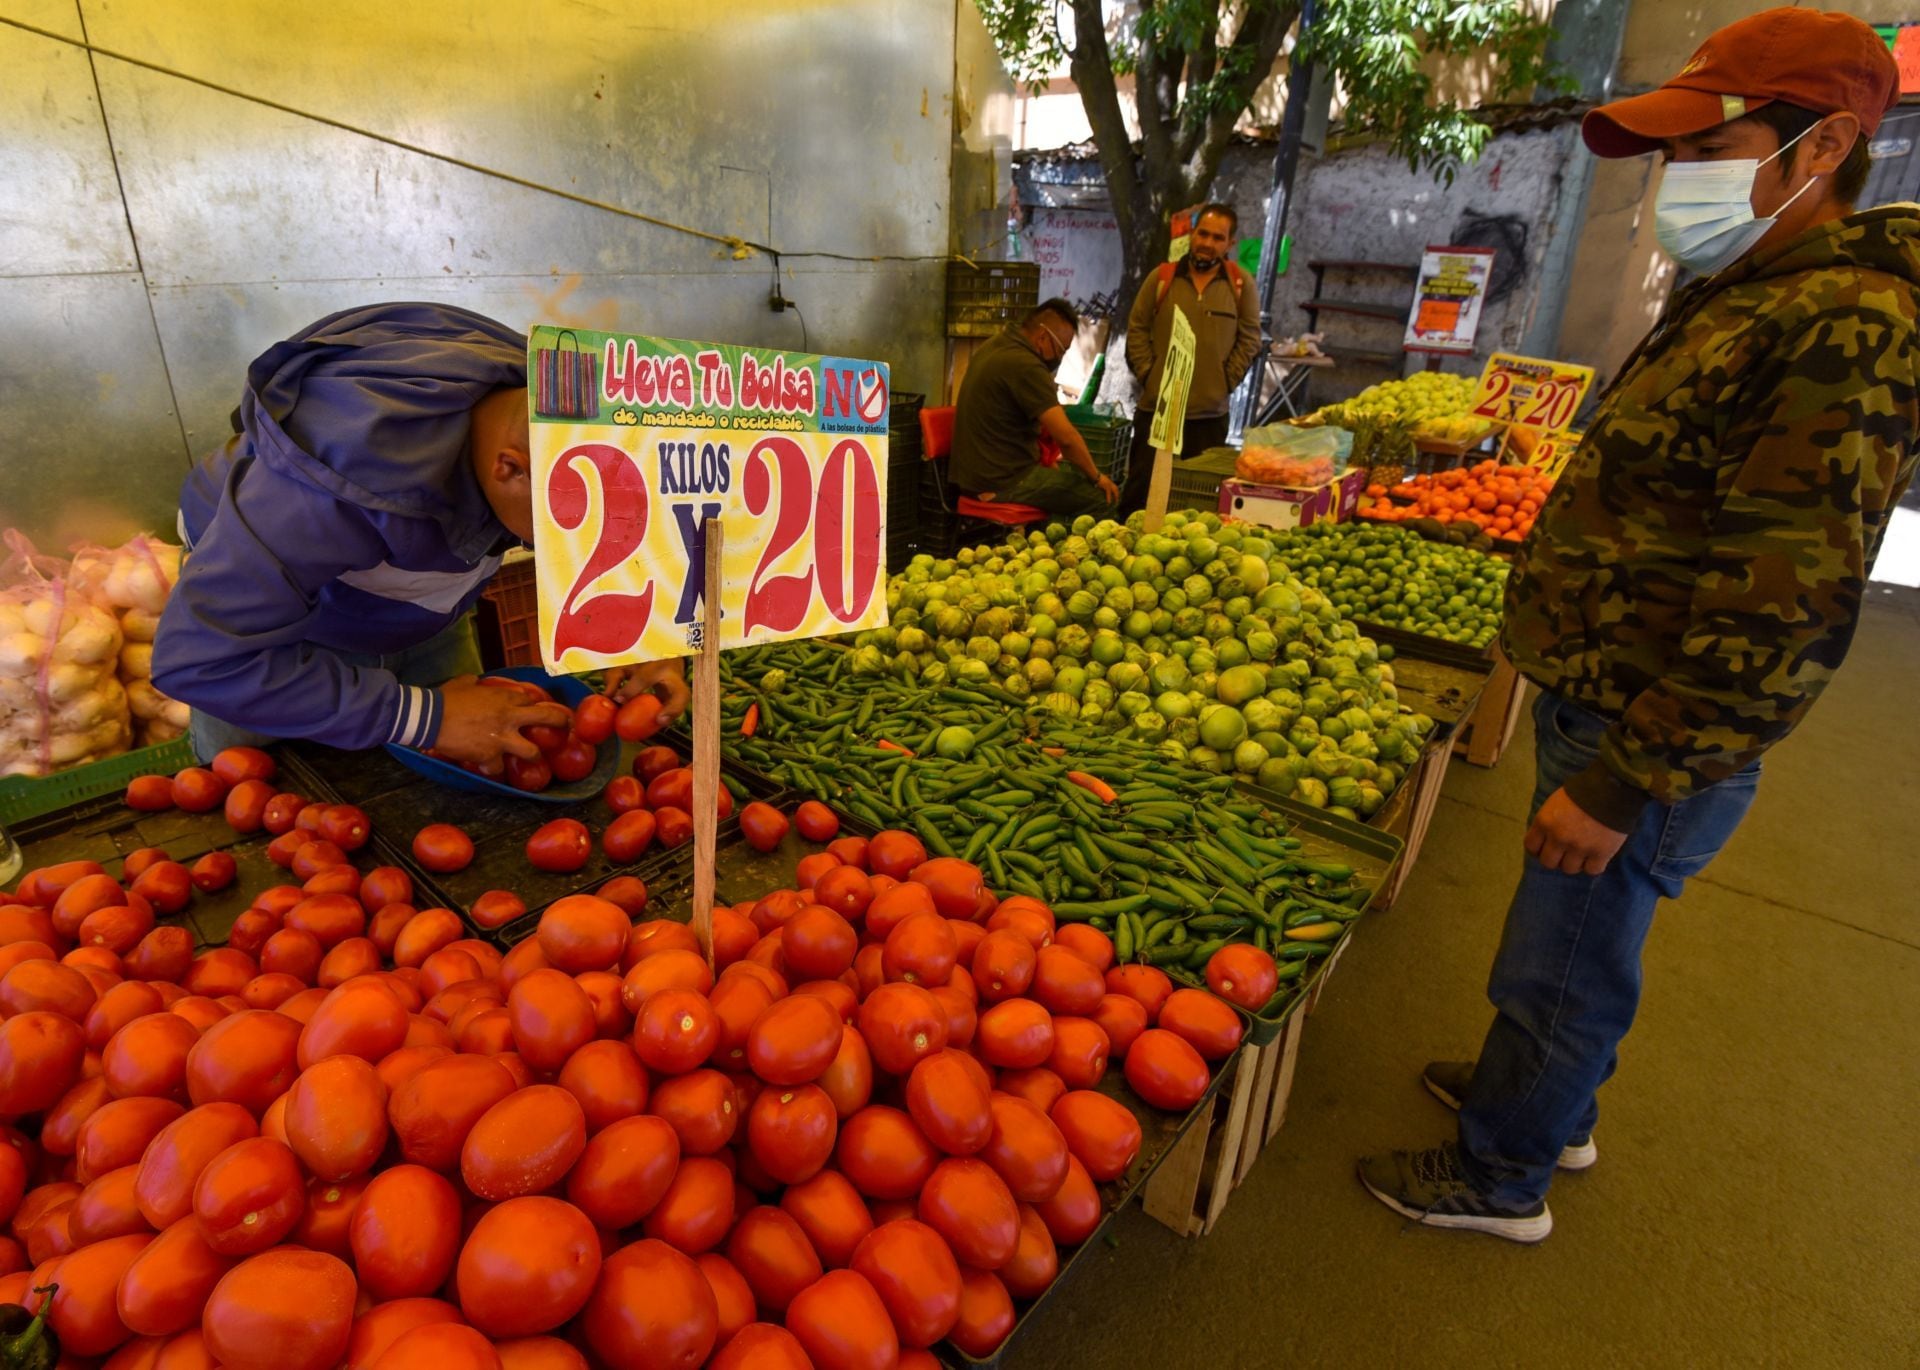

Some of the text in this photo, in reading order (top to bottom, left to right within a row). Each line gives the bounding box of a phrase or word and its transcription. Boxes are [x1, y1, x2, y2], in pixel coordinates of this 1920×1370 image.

[739, 352, 816, 417] Bolsa
[1473, 372, 1510, 417] 2
[1522, 381, 1577, 429] 20
[612, 408, 805, 432] de mandado o reciclable
[827, 423, 836, 432] las
[837, 423, 856, 433] bolsas
[857, 424, 865, 433] de
[658, 442, 730, 494] KILOS
[548, 443, 654, 662] 2
[743, 436, 881, 638] 20
